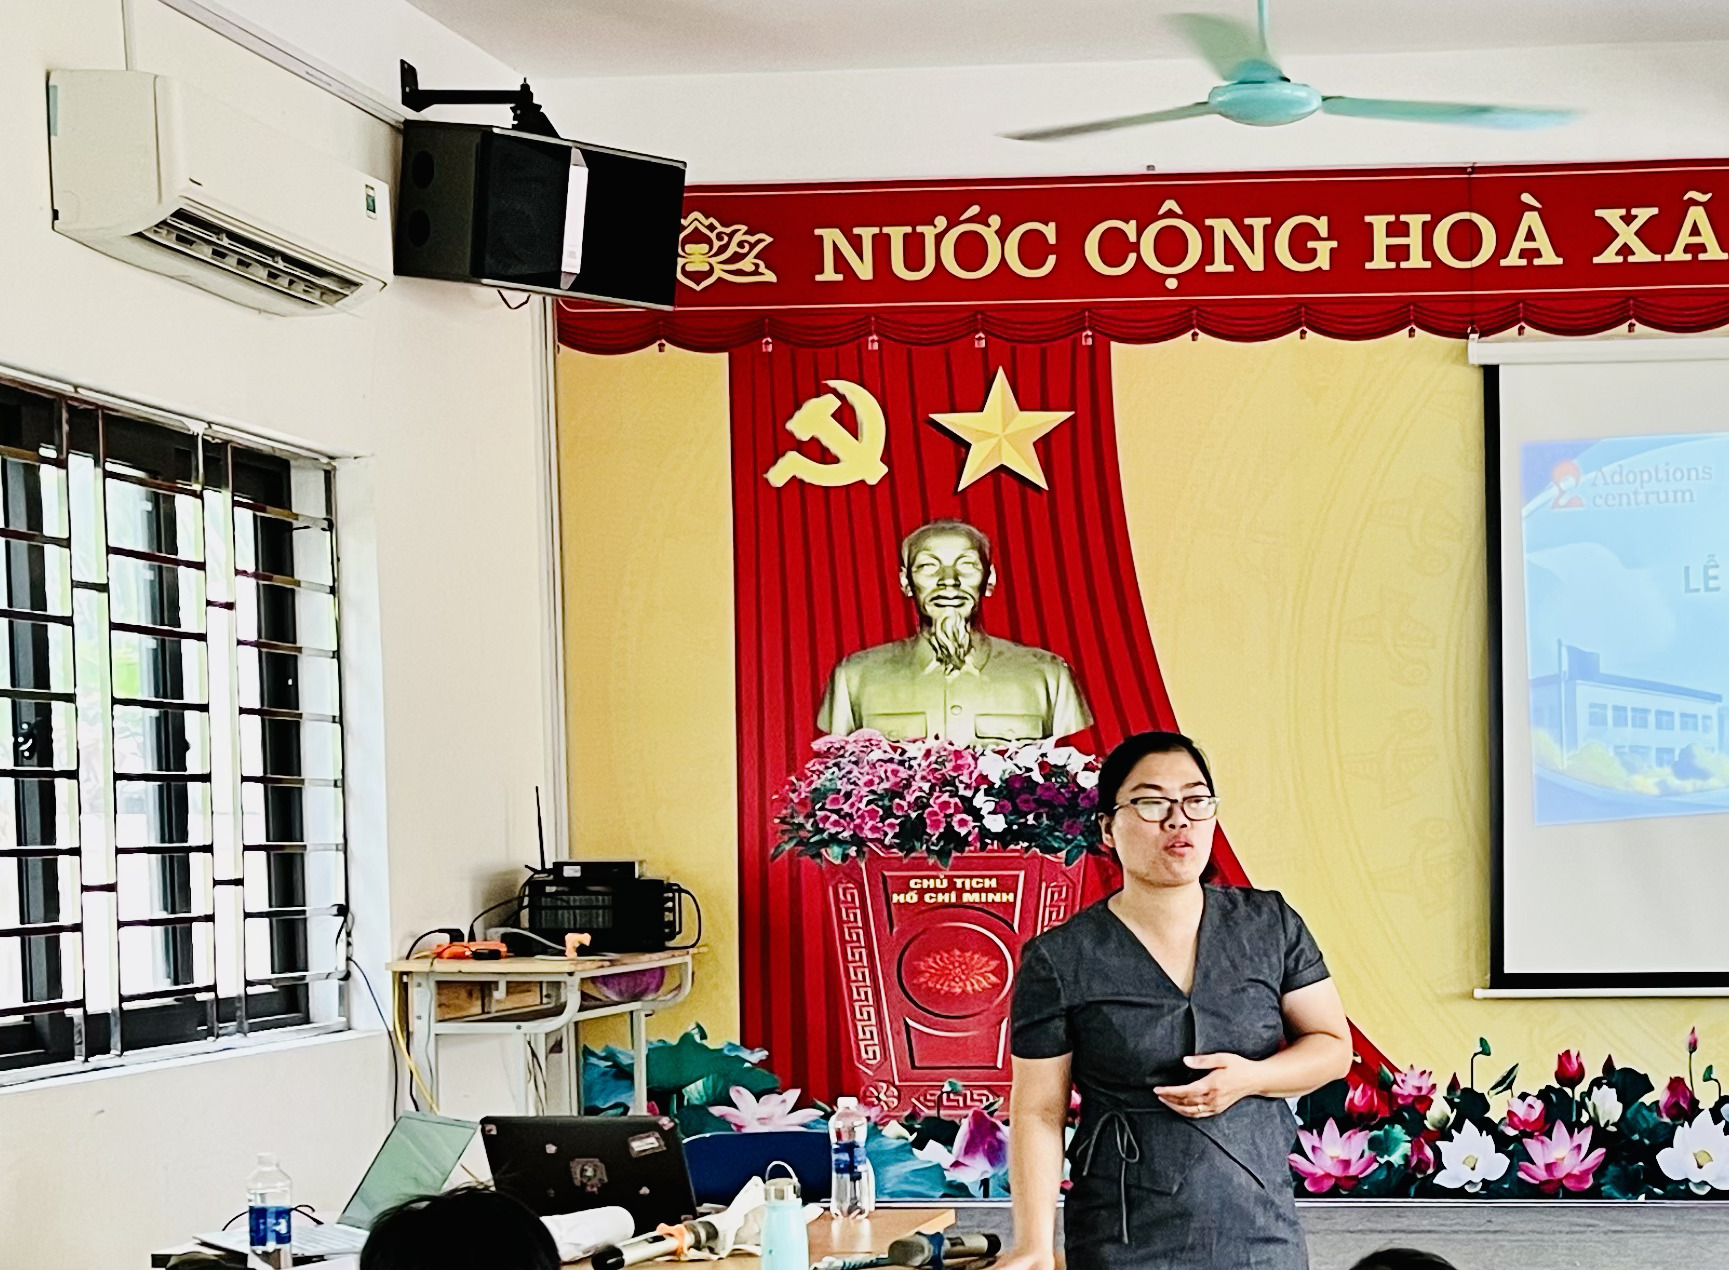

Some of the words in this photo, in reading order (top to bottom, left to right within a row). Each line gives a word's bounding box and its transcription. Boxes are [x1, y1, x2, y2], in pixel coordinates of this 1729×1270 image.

[815, 204, 1057, 282] NƯỚC
[1084, 199, 1337, 290] CỘNG
[1364, 192, 1563, 270] HOÀ
[1592, 190, 1729, 264] XÃ
[1590, 462, 1713, 489] Adoptions
[1592, 489, 1695, 508] centrum
[1683, 553, 1721, 594] LỄ
[909, 873, 948, 889] CHỦ
[953, 878, 997, 890] TỊCH
[924, 891, 956, 903] CHÍ
[962, 892, 1015, 903] MINH
